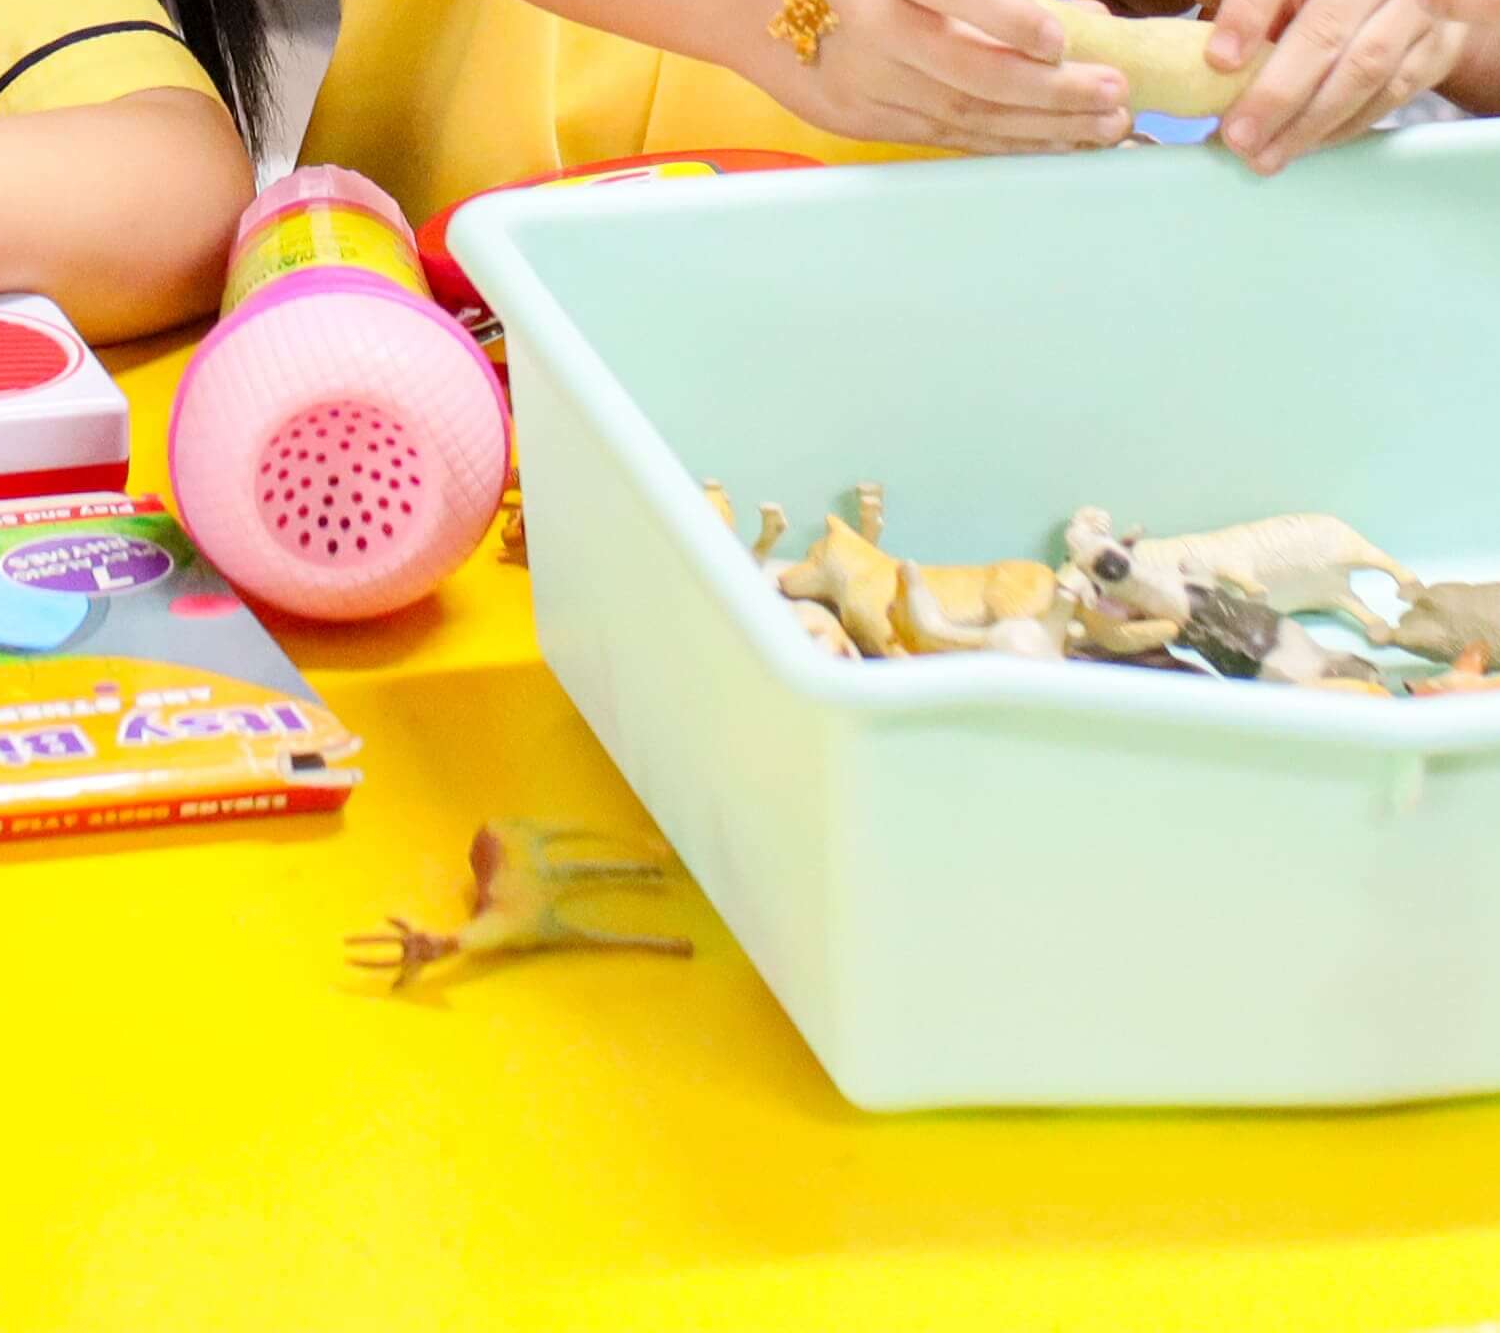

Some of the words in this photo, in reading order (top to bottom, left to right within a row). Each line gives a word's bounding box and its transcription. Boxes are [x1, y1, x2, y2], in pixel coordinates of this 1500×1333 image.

[23, 508, 72, 523] and
[80, 502, 136, 517] Play
[91, 565, 134, 590] 7
[135, 686, 211, 708] AND
[118, 701, 311, 746] Itsy
